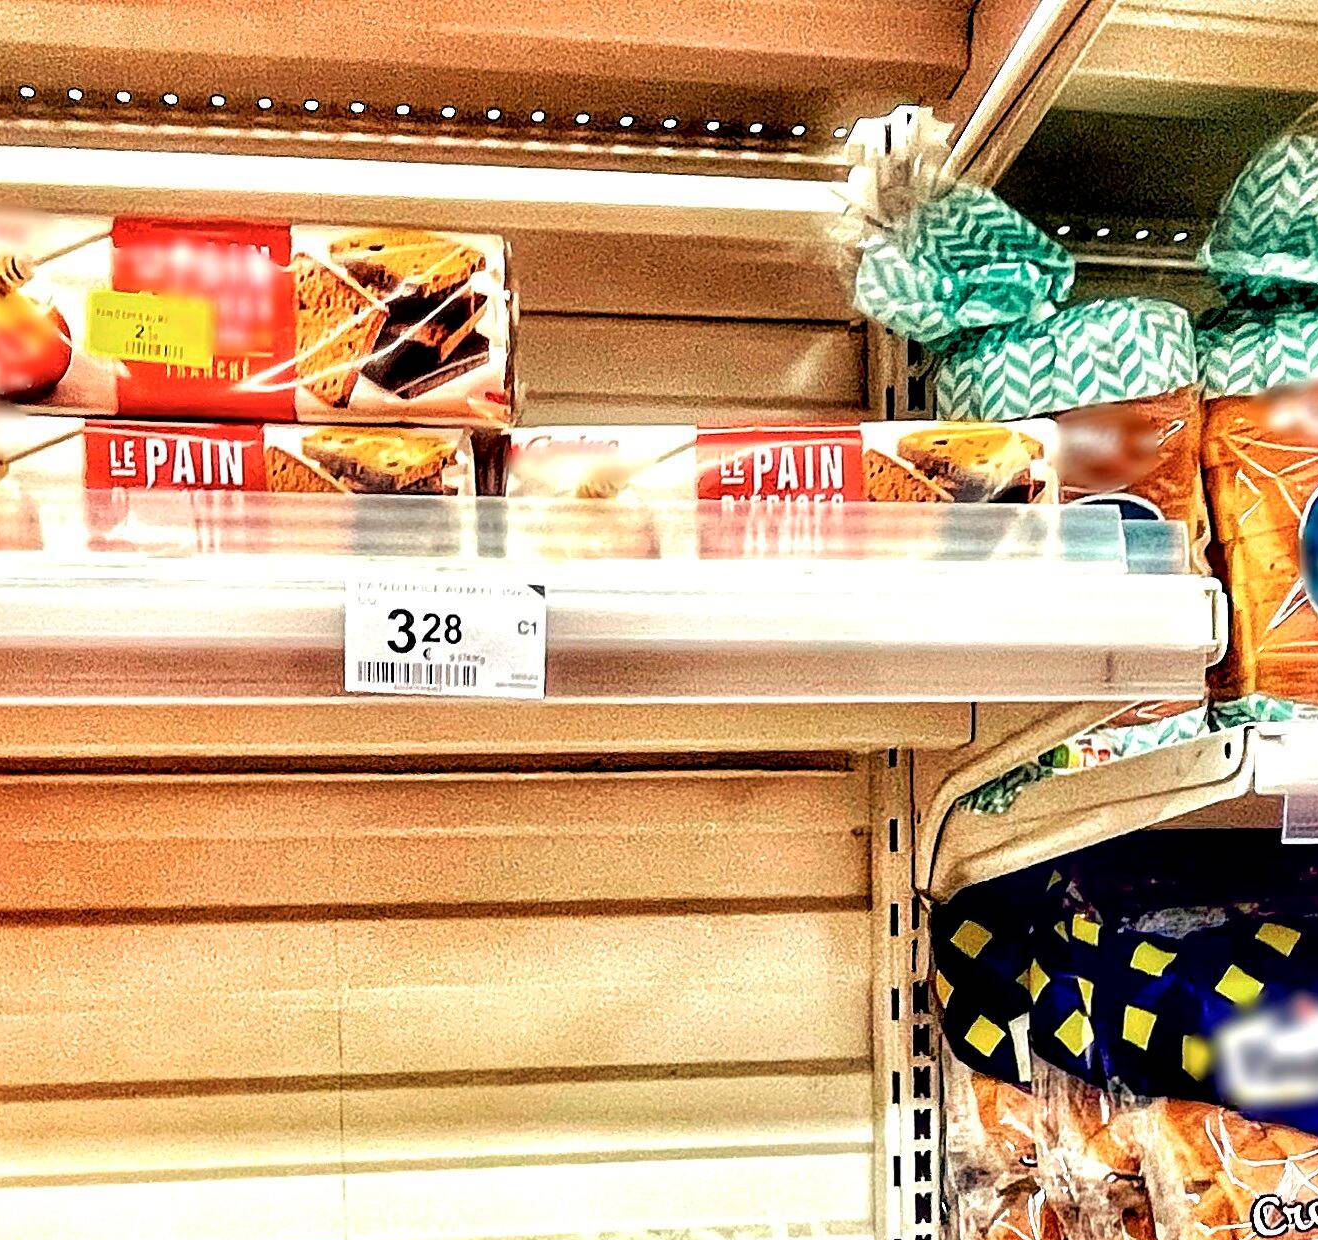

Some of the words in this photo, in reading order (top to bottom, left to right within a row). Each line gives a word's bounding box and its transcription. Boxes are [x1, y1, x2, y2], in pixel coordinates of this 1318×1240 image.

[109, 439, 136, 468] LE
[145, 438, 244, 489] PAIN
[720, 452, 745, 477] LE
[752, 445, 843, 495] PAIN
[517, 620, 537, 636] C1
